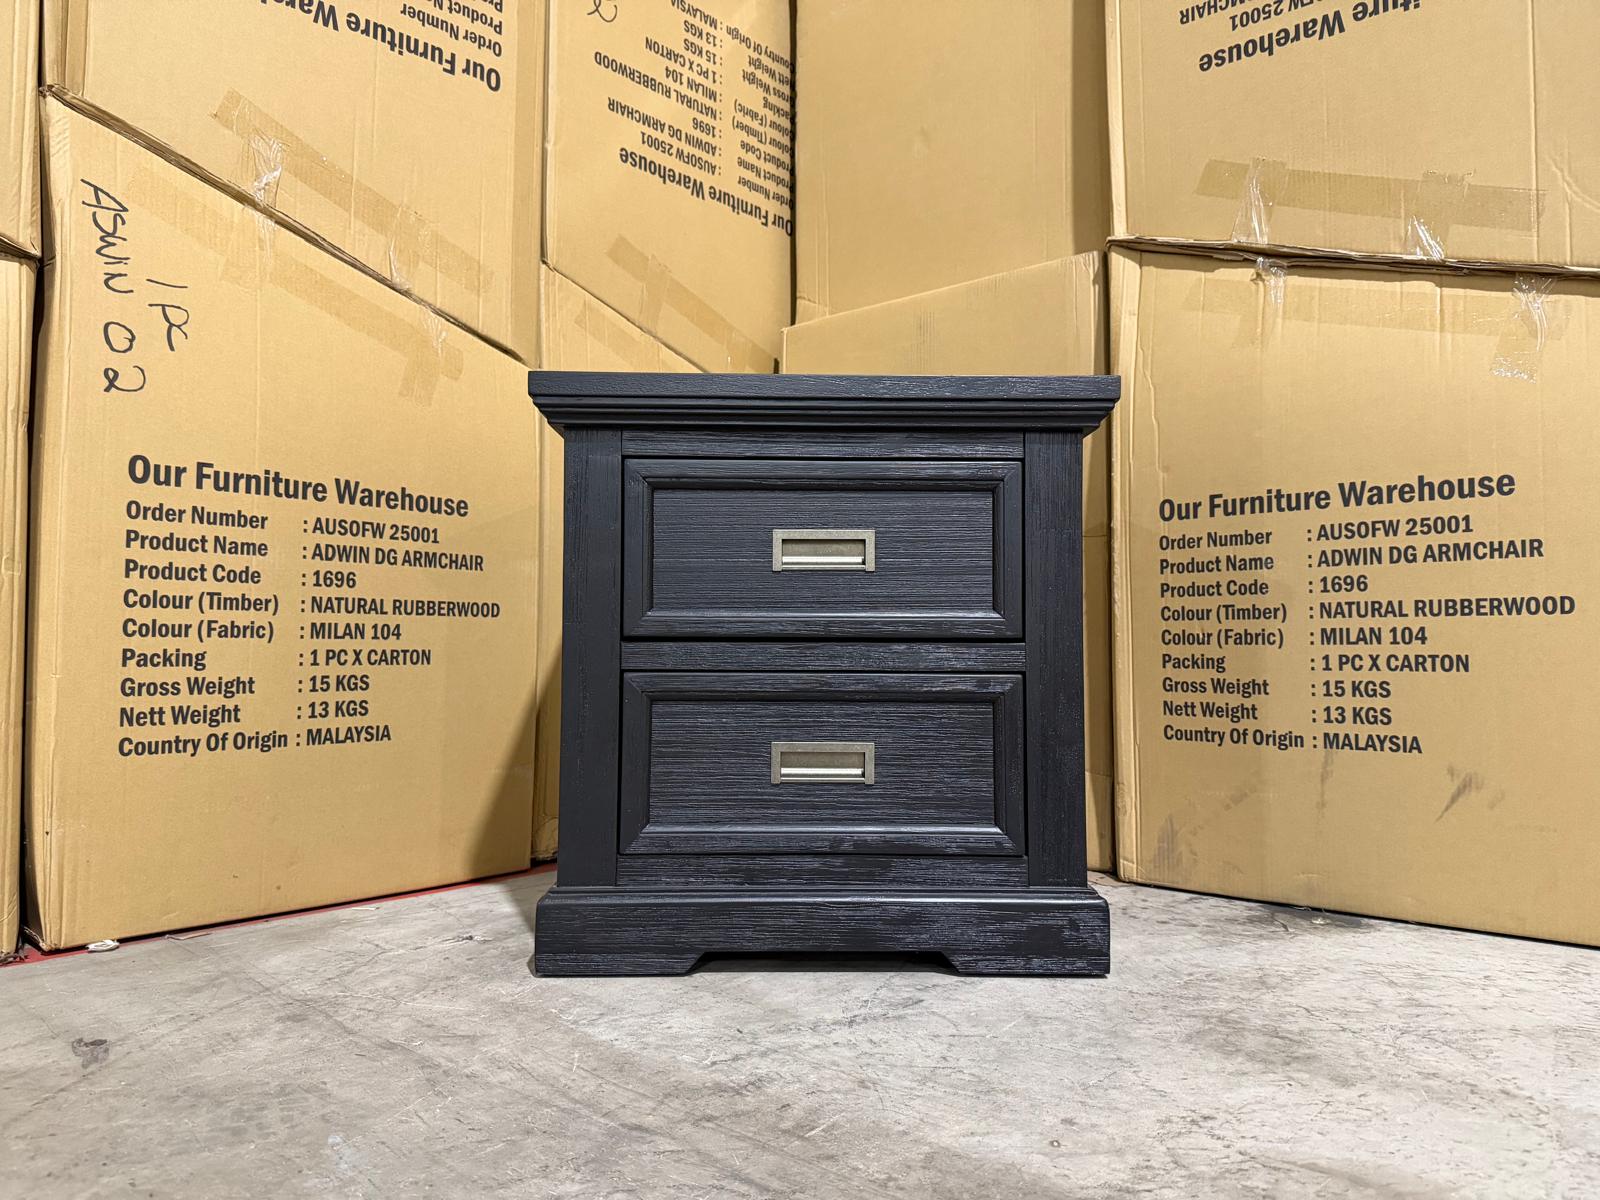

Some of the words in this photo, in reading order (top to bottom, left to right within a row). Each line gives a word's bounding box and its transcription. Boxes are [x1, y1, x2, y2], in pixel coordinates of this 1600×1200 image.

[400, 2, 461, 40] Number
[1229, 0, 1283, 31] 25001
[346, 12, 457, 75] Furniture
[463, 30, 502, 57] Order
[684, 20, 703, 40] KGS
[706, 31, 716, 48] 13
[726, 25, 751, 49] Origin
[1199, 10, 1345, 71] Warehouse
[646, 37, 685, 68] CARTON
[684, 39, 703, 59] KGS
[706, 50, 716, 66] 15
[753, 41, 762, 55] Of
[462, 59, 500, 92] Our
[595, 51, 671, 100] RUBBERWOOD
[665, 67, 683, 85] 104
[688, 60, 694, 74] X
[696, 63, 708, 79] PC
[711, 71, 716, 84] 1
[748, 55, 776, 83] Weight
[687, 76, 716, 102] MILAN
[742, 69, 771, 96] Weight
[608, 97, 666, 133] ARMCHAIR
[674, 89, 716, 120] NATURAL
[734, 100, 767, 128] (Fabric)
[668, 125, 681, 141] DG
[692, 117, 716, 138] 1696
[732, 117, 767, 146] (Timber)
[640, 131, 673, 156] 25001
[685, 132, 716, 156] ADWIN
[741, 140, 761, 161] Code
[619, 148, 704, 201] Warehouse
[676, 147, 716, 176] AUSOFW
[737, 157, 761, 178] Name
[738, 176, 770, 201] Number
[708, 186, 768, 227] Furniture
[771, 214, 793, 237] Our
[128, 455, 187, 487] Our
[196, 462, 327, 502] Furniture
[335, 478, 468, 517] Warehouse
[1159, 499, 1202, 521] Our
[1209, 489, 1330, 517] Furniture
[1338, 475, 1515, 507] Warehouse
[127, 500, 186, 523] Order
[192, 506, 268, 529] Number
[312, 517, 386, 539] AUSOFW
[390, 524, 439, 543] 25001
[1159, 534, 1203, 550] Order
[1207, 530, 1272, 547] Number
[1317, 519, 1400, 541] AUSOFW
[1406, 515, 1473, 536] 25001
[126, 529, 208, 553] Product
[214, 536, 268, 556] Name
[312, 543, 369, 563] ADWIN
[375, 548, 397, 565] DG
[402, 550, 483, 571] ARMCHAIR
[1160, 556, 1221, 575] Product
[1226, 555, 1274, 571] Name
[1317, 547, 1382, 567] ADWIN
[1389, 545, 1417, 564] DG
[1423, 539, 1544, 562] ARMCHAIR
[125, 559, 207, 581] Product
[213, 564, 261, 584] Code
[313, 570, 356, 588] 1696
[1161, 581, 1222, 598] Product
[1227, 579, 1268, 596] Code
[1320, 575, 1368, 593] 1696
[124, 589, 193, 609] Colour
[199, 592, 278, 616] (Timber)
[311, 596, 388, 615] NATURAL
[393, 599, 500, 617] RUBBERWOOD
[1161, 606, 1212, 621] Colour
[1217, 603, 1286, 624] (Timber)
[1320, 600, 1408, 619] NATURAL
[1414, 596, 1575, 617] RUBBERWOOD
[123, 618, 192, 637] Colour
[198, 620, 273, 643] (Fabric)
[311, 622, 365, 639] MILAN
[371, 624, 401, 640] 104
[1162, 629, 1213, 645] Colour
[1217, 629, 1283, 649] (Fabric)
[1321, 627, 1381, 645] MILAN
[1389, 627, 1427, 645] 104
[122, 648, 207, 671] Packing
[310, 649, 319, 666] 1
[325, 649, 348, 666] PC
[352, 649, 363, 666] X
[367, 649, 431, 665] CARTON
[1162, 654, 1226, 673] Packing
[1322, 655, 1332, 671] 1
[1338, 654, 1363, 671] PC
[1368, 654, 1381, 671] X
[1386, 654, 1469, 672] CARTON
[121, 678, 181, 697] Gross
[186, 677, 255, 699] Weight
[309, 675, 330, 692] 15
[336, 674, 369, 691] KGS
[1163, 677, 1207, 693] Gross
[1210, 678, 1269, 698] Weight
[1323, 680, 1345, 697] 15
[1352, 681, 1391, 698] KGS
[120, 707, 165, 727] Nett
[171, 705, 240, 727] Weight
[308, 701, 329, 719] 13
[335, 700, 368, 717] KGS
[1163, 700, 1196, 717] Nett
[1200, 702, 1258, 723] Weight
[1324, 706, 1346, 724] 13
[1353, 707, 1392, 725] KGS
[119, 736, 201, 757] Country
[206, 732, 228, 751] Of
[233, 730, 287, 752] Origin
[307, 725, 391, 746] MALAYSIA
[1164, 725, 1225, 747] Country
[1230, 728, 1248, 744] Of
[1253, 729, 1304, 750] Origin
[1324, 733, 1422, 753] MALAYSIA
